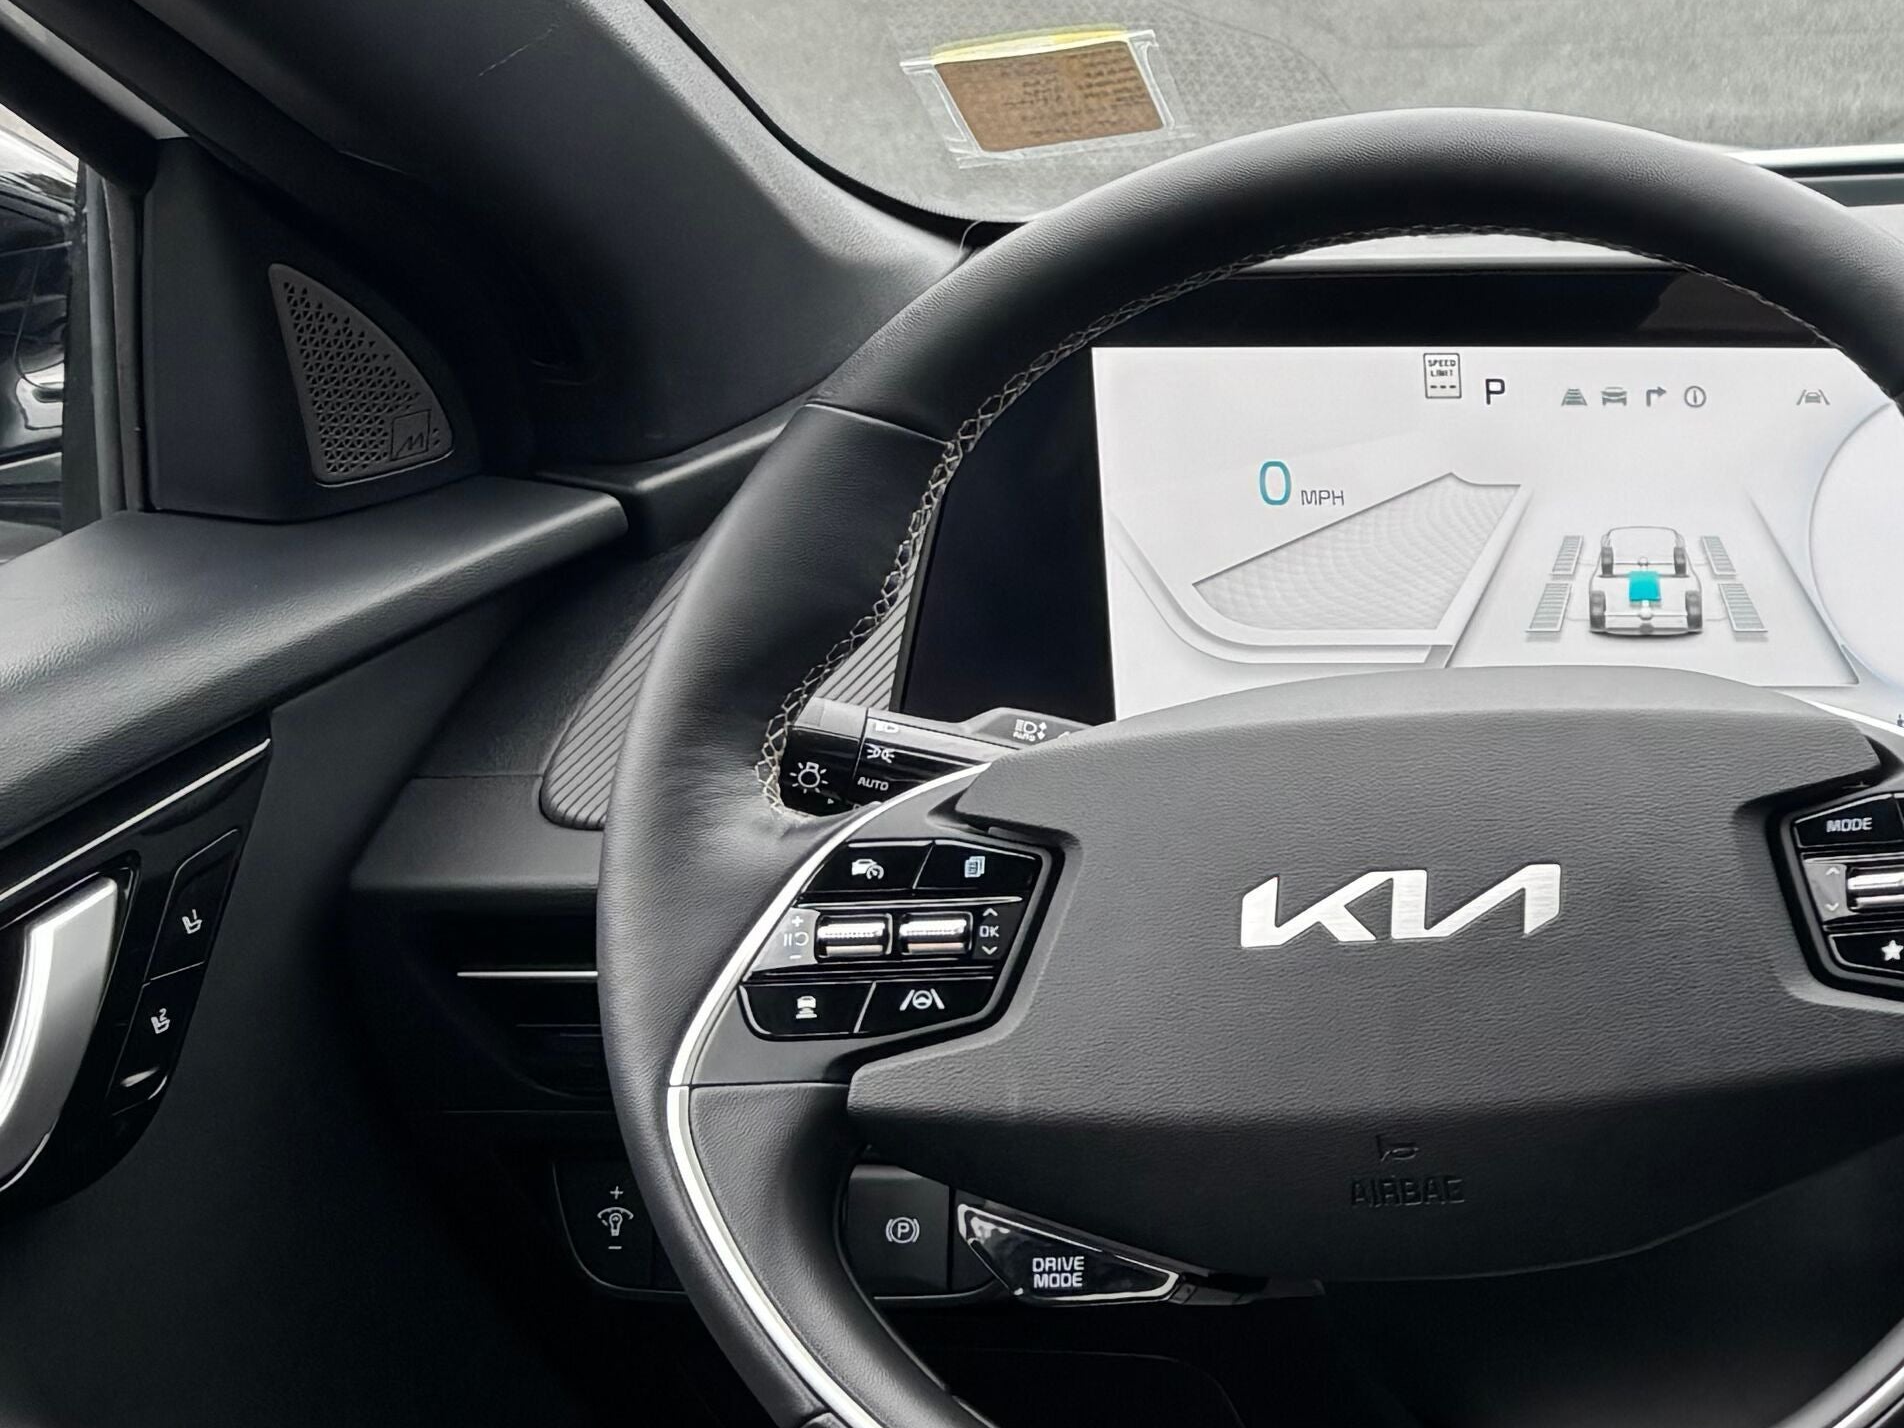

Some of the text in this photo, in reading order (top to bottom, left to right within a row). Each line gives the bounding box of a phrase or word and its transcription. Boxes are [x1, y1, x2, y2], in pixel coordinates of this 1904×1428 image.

[1427, 359, 1456, 367] SPEED
[1485, 378, 1505, 405] P
[1258, 460, 1346, 508] 0 MPH
[857, 776, 889, 791] AUTO
[1826, 817, 1873, 833] MODE
[1240, 863, 1561, 949] KIA
[978, 925, 1000, 939] OK
[1031, 1256, 1085, 1273] DRIVE
[1033, 1273, 1084, 1289] MODE
